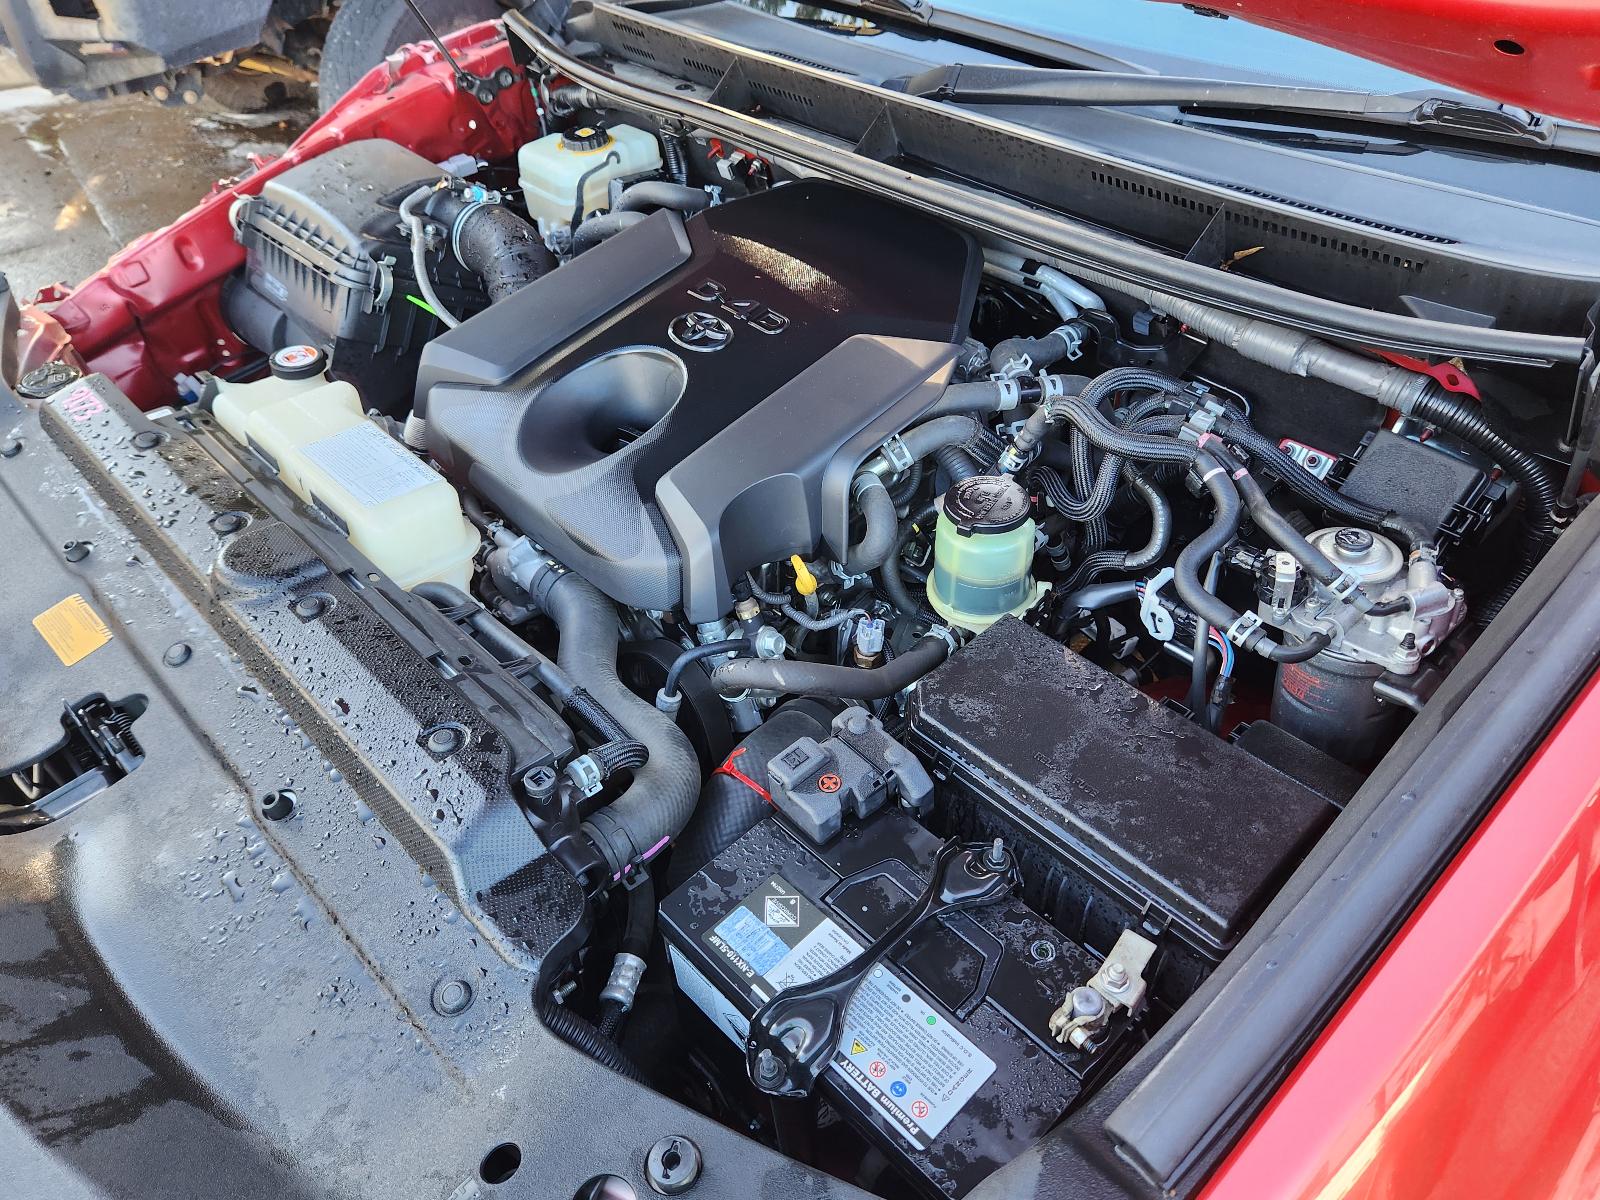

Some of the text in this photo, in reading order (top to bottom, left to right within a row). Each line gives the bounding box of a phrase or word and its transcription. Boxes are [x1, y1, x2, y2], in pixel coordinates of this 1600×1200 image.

[771, 898, 797, 921] CORROSIVE
[709, 935, 755, 978] E-NX110-5LMF
[840, 1059, 881, 1099] BATTERY
[881, 1095, 920, 1136] Premium
